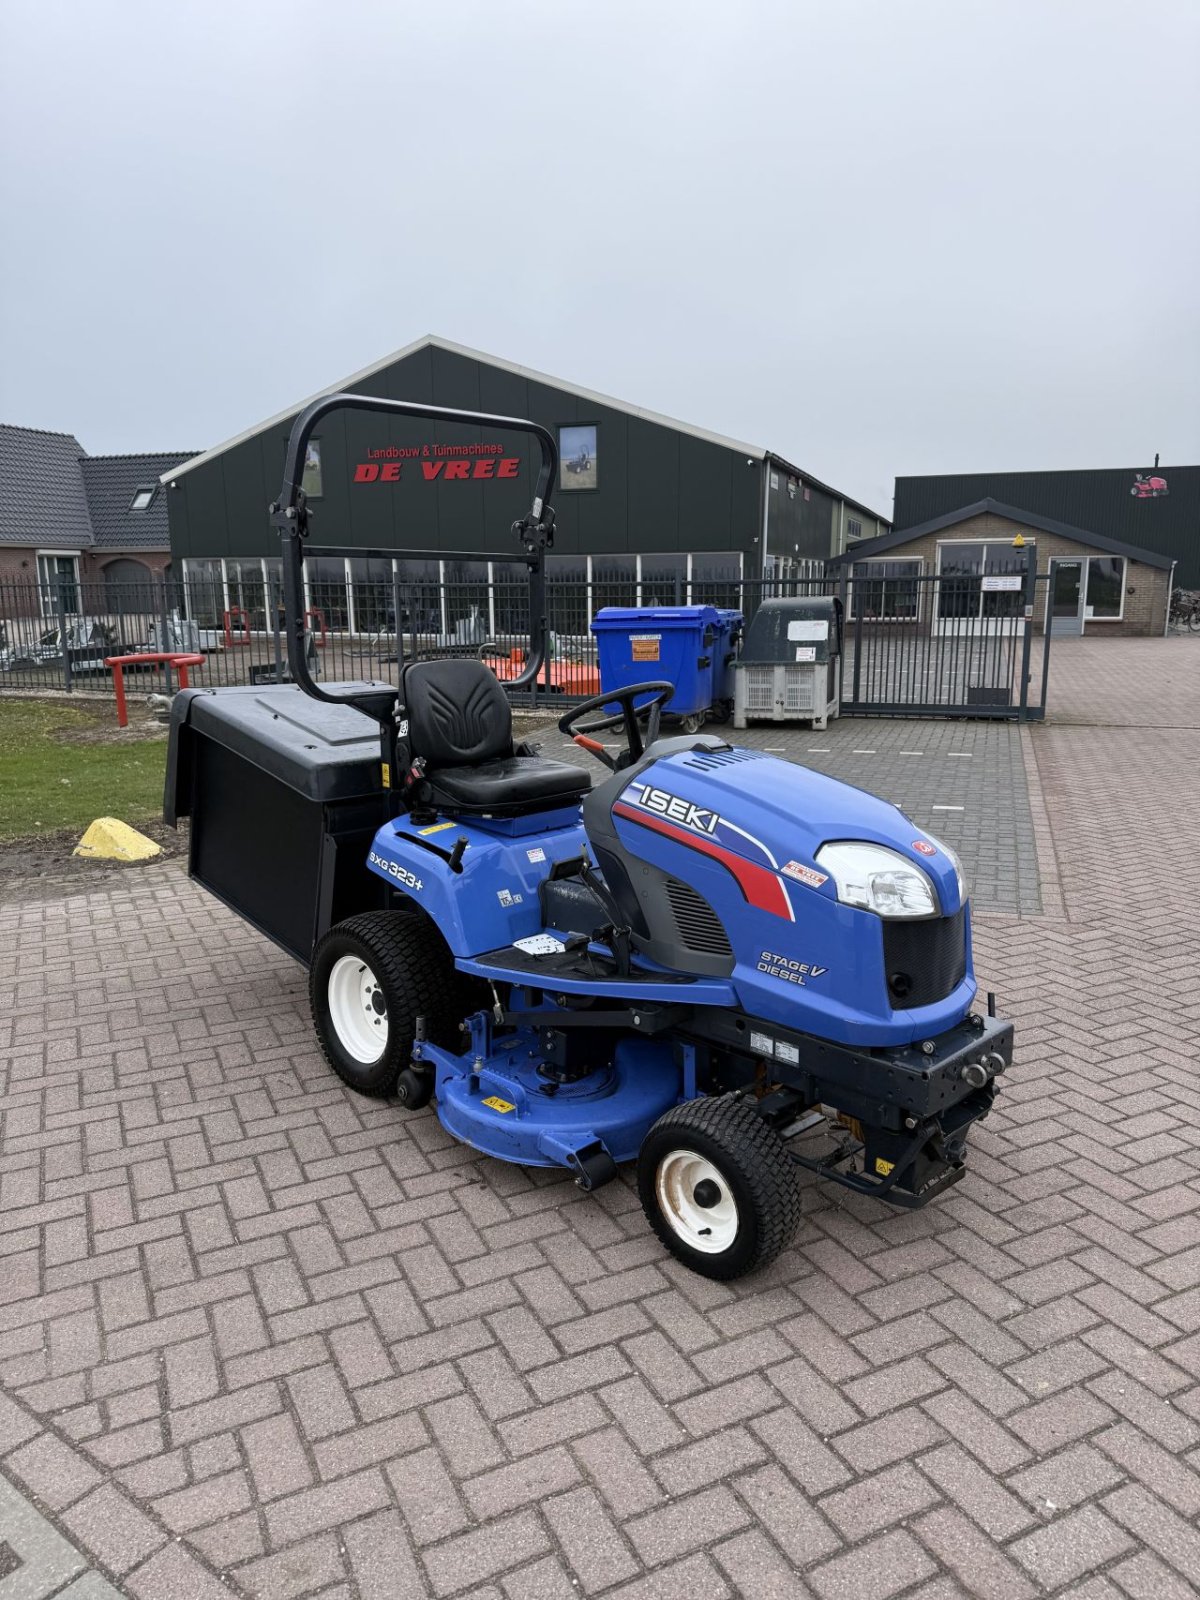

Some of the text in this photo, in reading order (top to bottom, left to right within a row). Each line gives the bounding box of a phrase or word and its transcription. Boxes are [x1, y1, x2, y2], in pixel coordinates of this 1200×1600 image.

[367, 442, 504, 460] Landbouw & Tuinmachines
[353, 457, 521, 483] DE VREE
[639, 784, 720, 835] ISEKI
[756, 961, 806, 986] DIESEL
[760, 951, 828, 977] STAGE V
